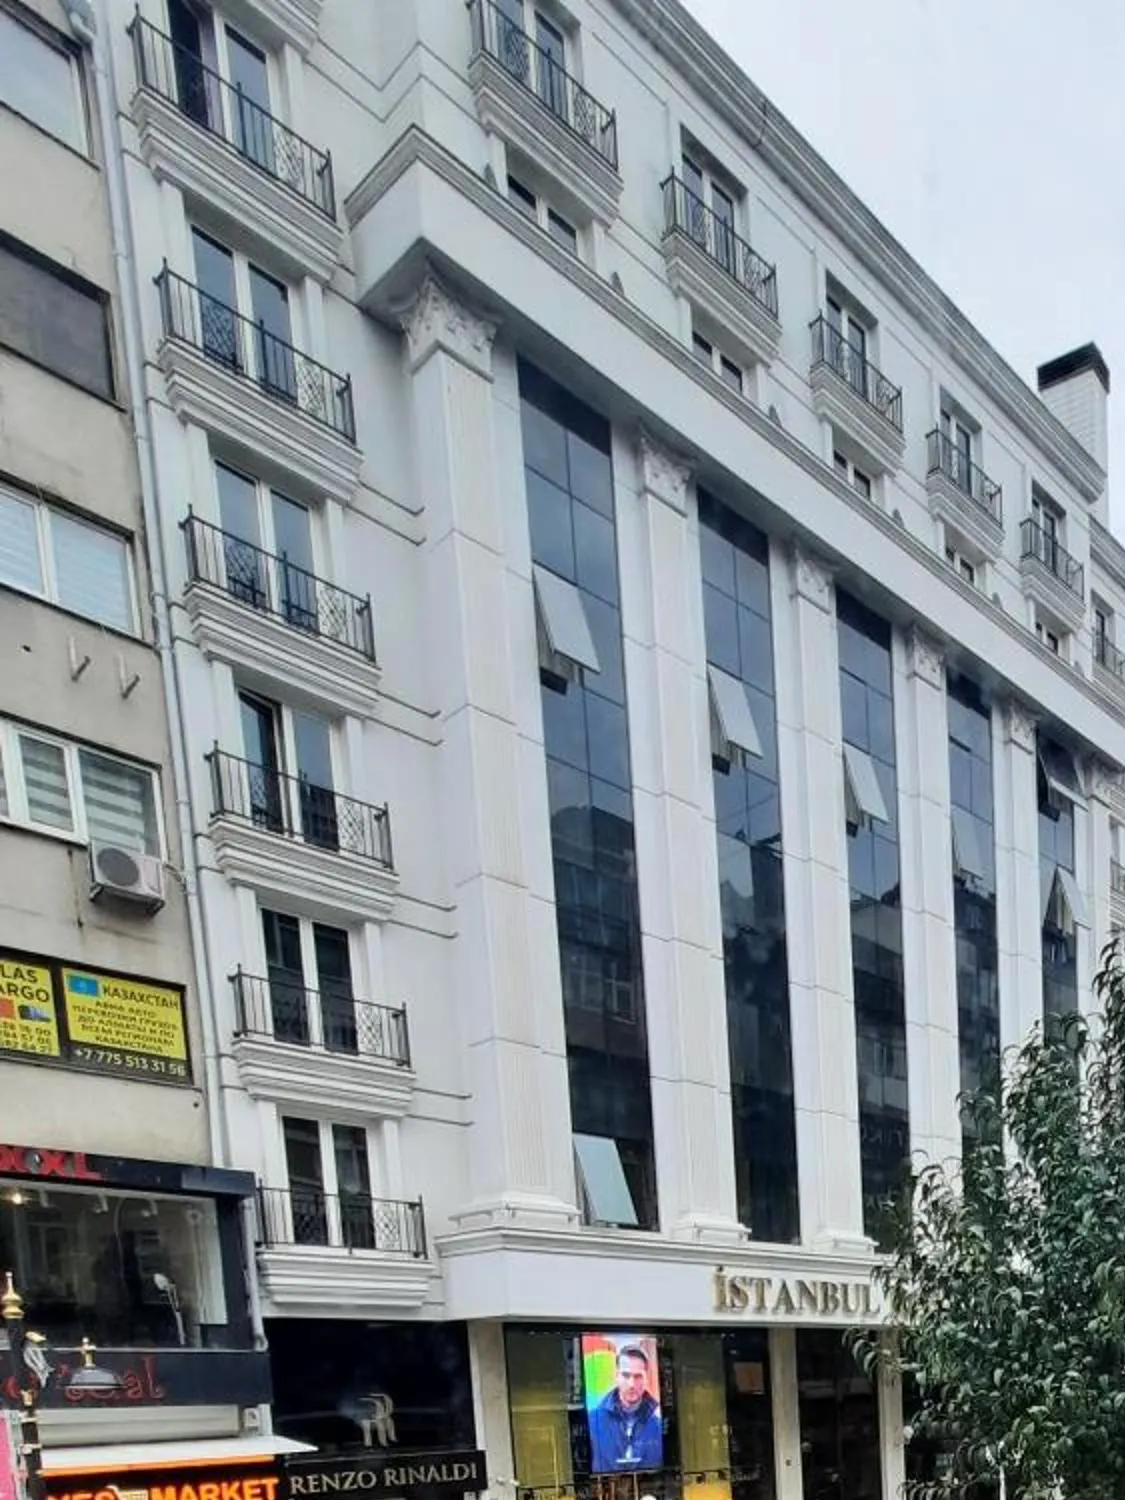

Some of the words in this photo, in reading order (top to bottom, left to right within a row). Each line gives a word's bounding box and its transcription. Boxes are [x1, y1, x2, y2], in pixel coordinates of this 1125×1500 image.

[0, 964, 38, 983] LAS
[103, 984, 180, 1009] КАЗАХСТАН
[95, 1050, 121, 1065] 775
[125, 1055, 148, 1071] 513
[151, 1060, 166, 1073] 31
[712, 1264, 880, 1317] İSTANBUL
[289, 1470, 377, 1495] RENZO
[383, 1462, 477, 1487] RINALDI
